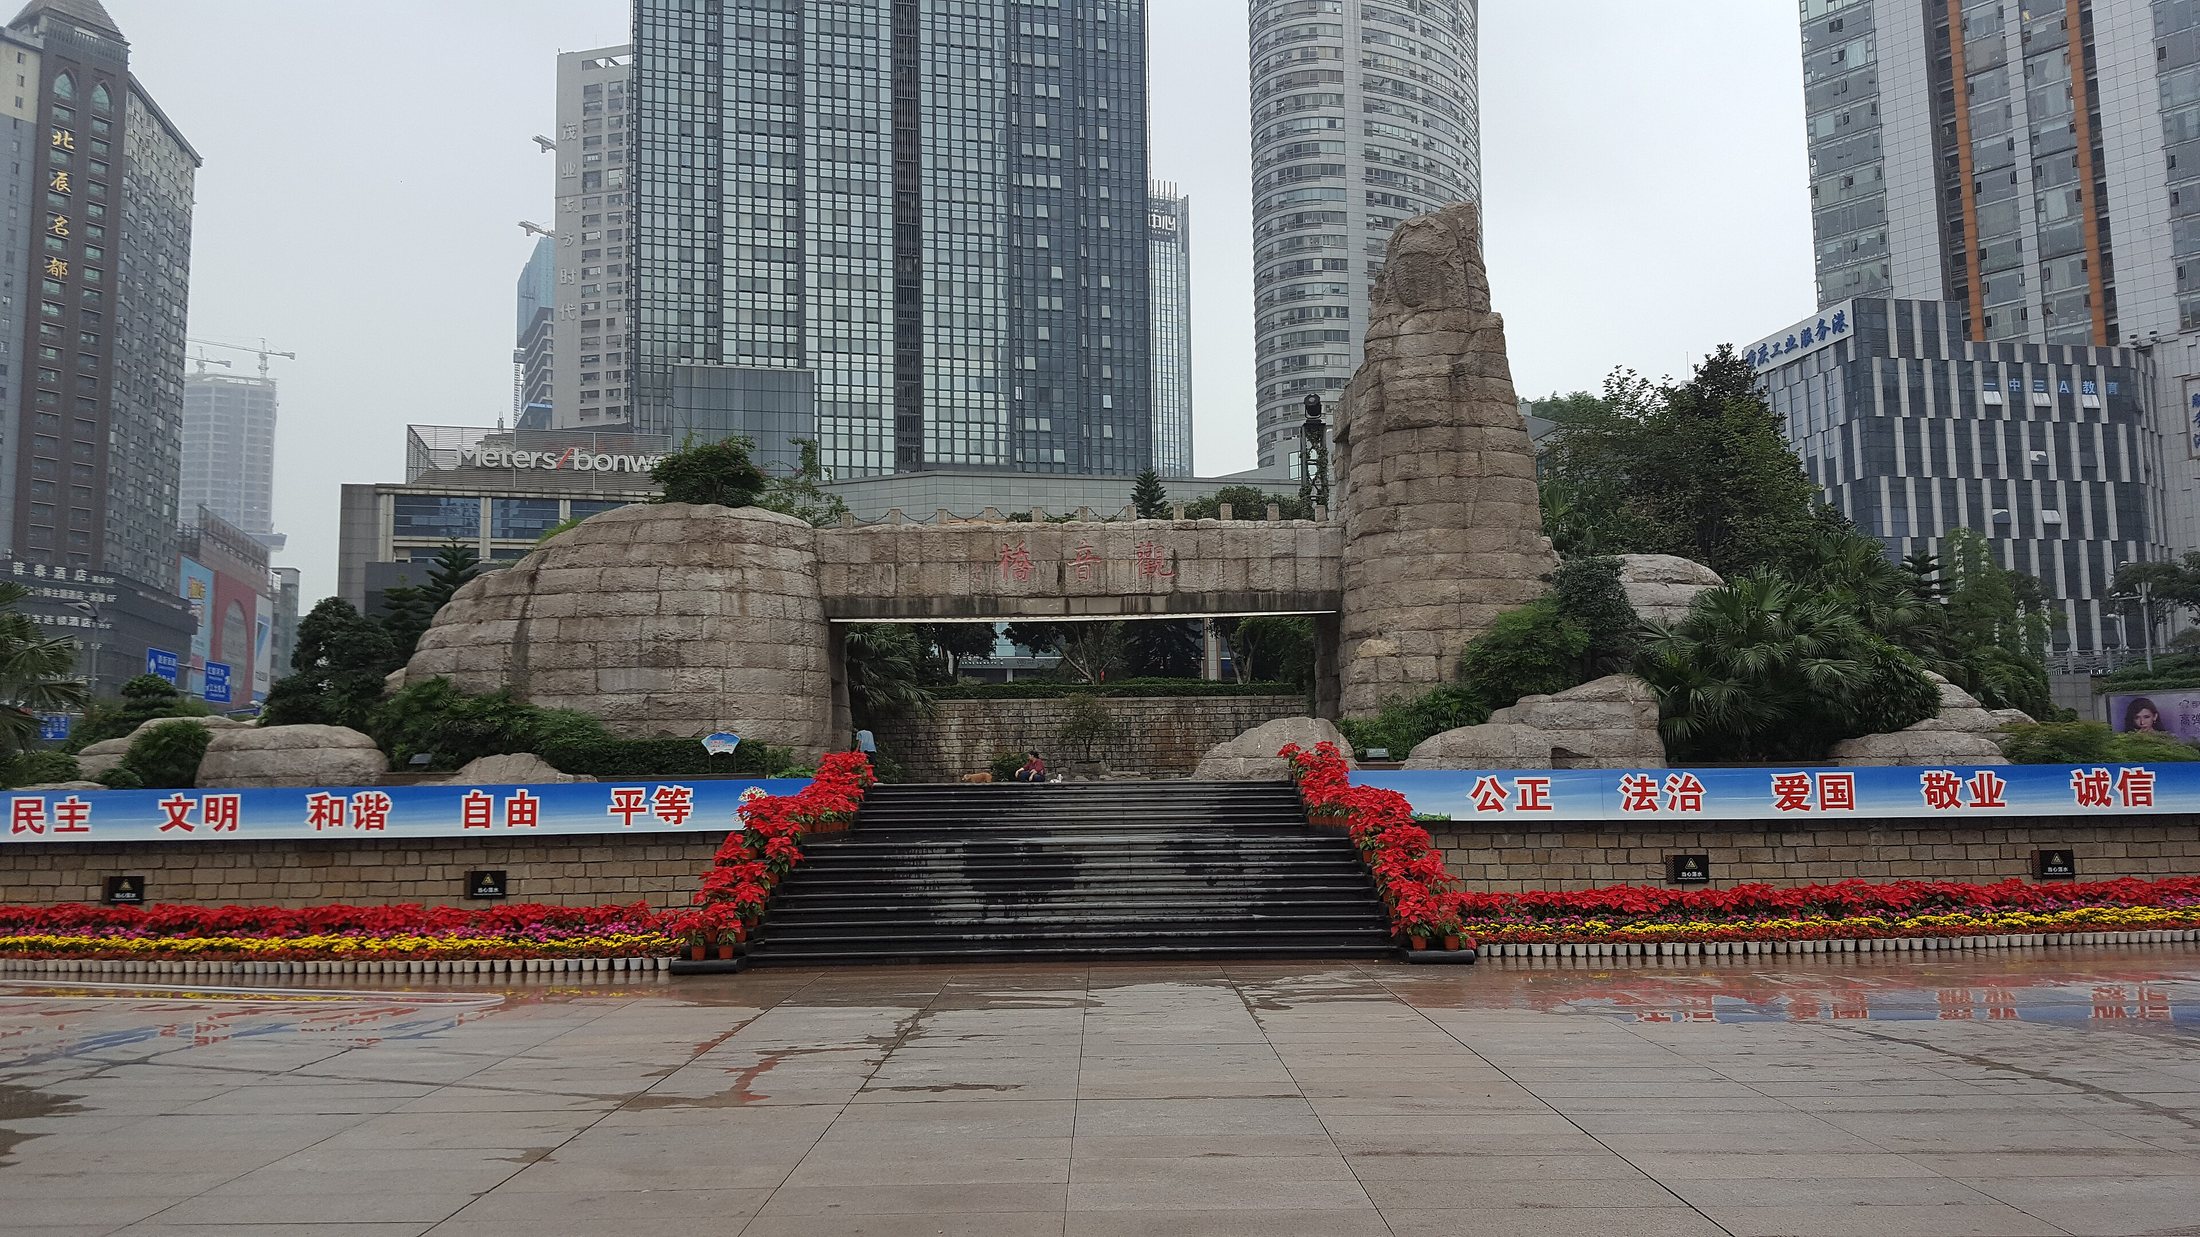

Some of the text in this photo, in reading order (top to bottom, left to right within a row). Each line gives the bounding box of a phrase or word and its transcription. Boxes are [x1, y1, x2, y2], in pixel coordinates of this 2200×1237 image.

[44, 130, 75, 279] 北辰名都
[1746, 309, 1849, 370] 重庆工业服务港
[11, 786, 691, 834] 民主 文明 和谐 自由 平等
[1470, 769, 2154, 813] 公正 法治 爱国 敬业 诚信
